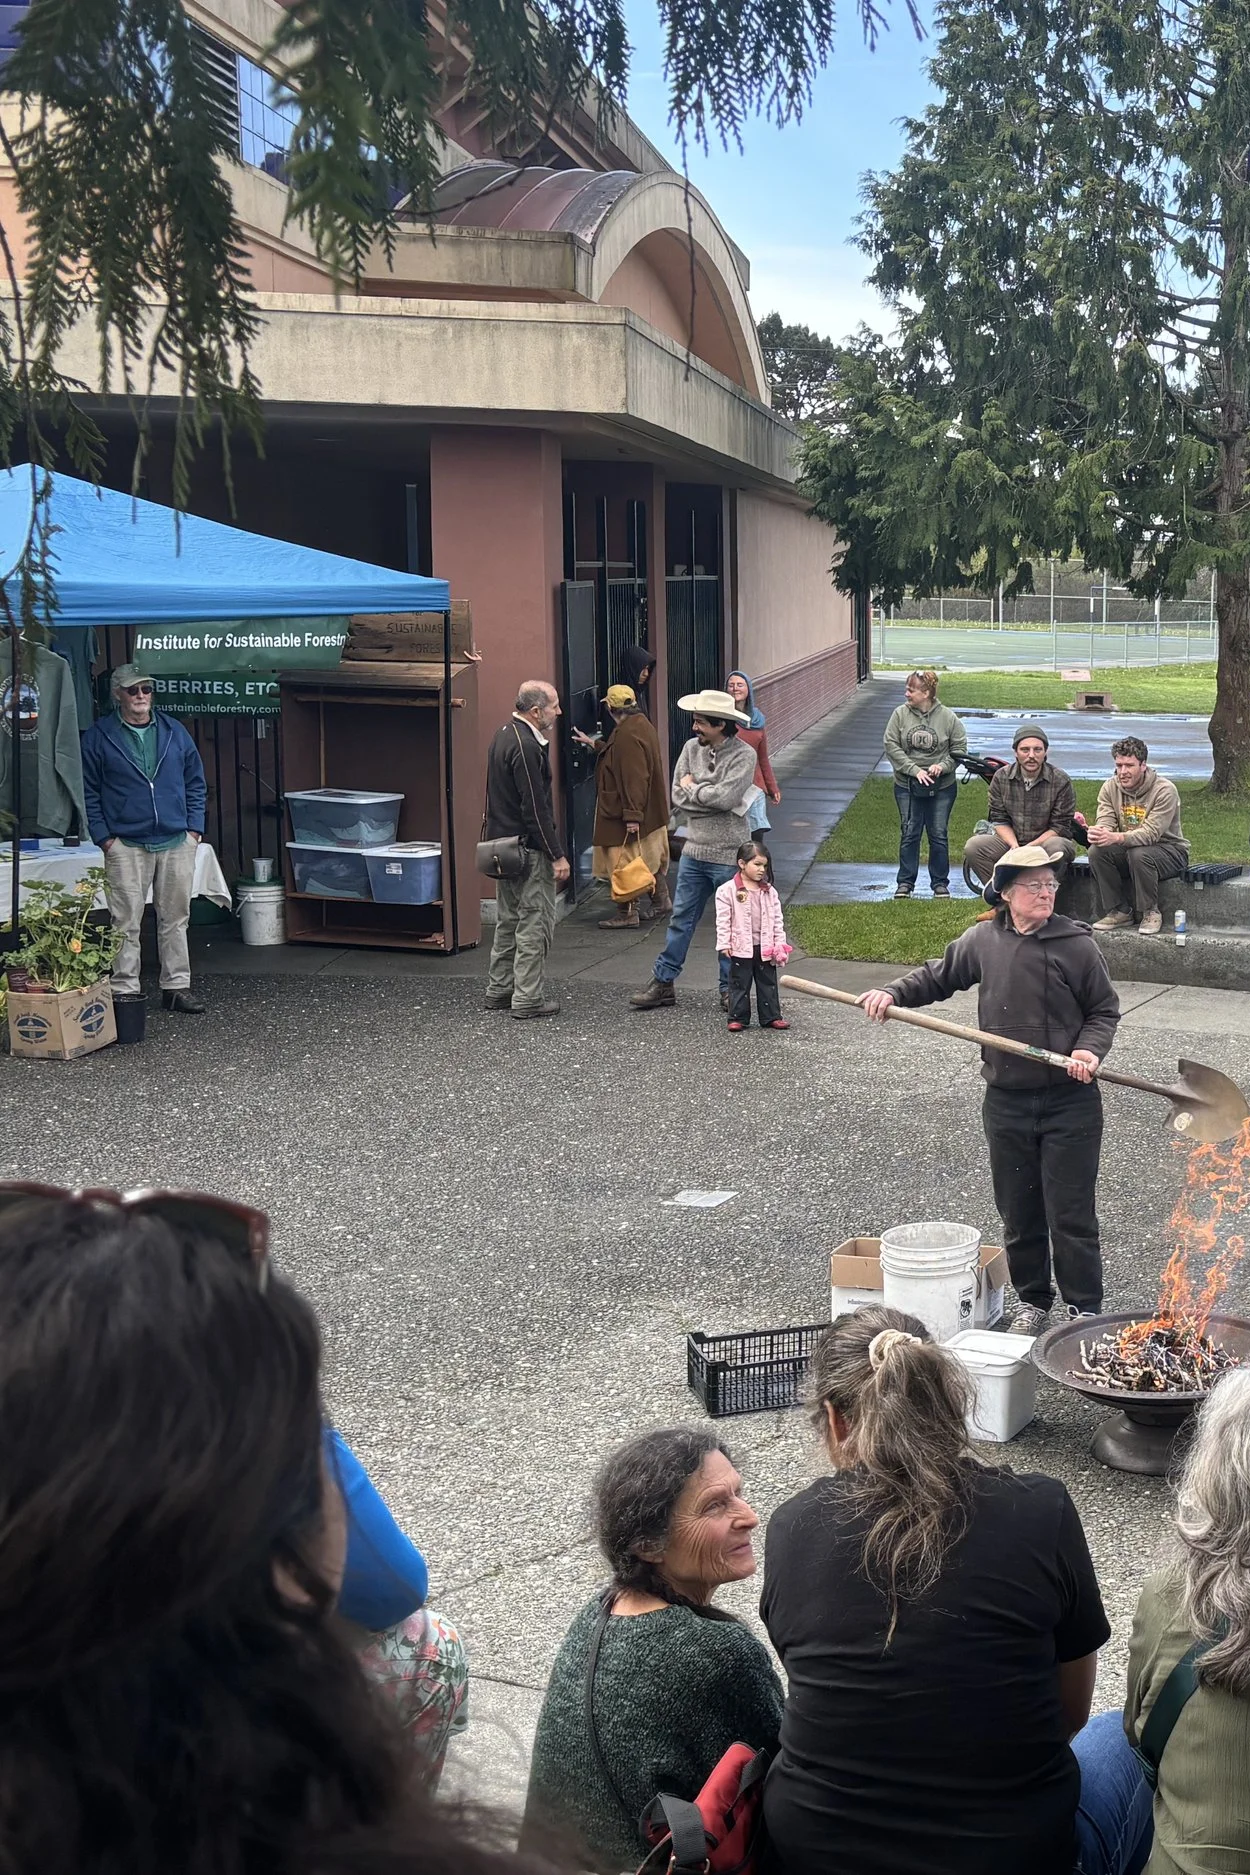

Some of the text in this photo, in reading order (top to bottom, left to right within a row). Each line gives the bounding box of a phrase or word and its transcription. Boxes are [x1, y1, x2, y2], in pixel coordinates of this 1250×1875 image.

[387, 622, 458, 636] SUSTAINABE
[136, 633, 200, 650] Institute
[204, 633, 223, 649] for
[224, 632, 301, 648] Sustainable
[152, 679, 239, 698] BERRIES,
